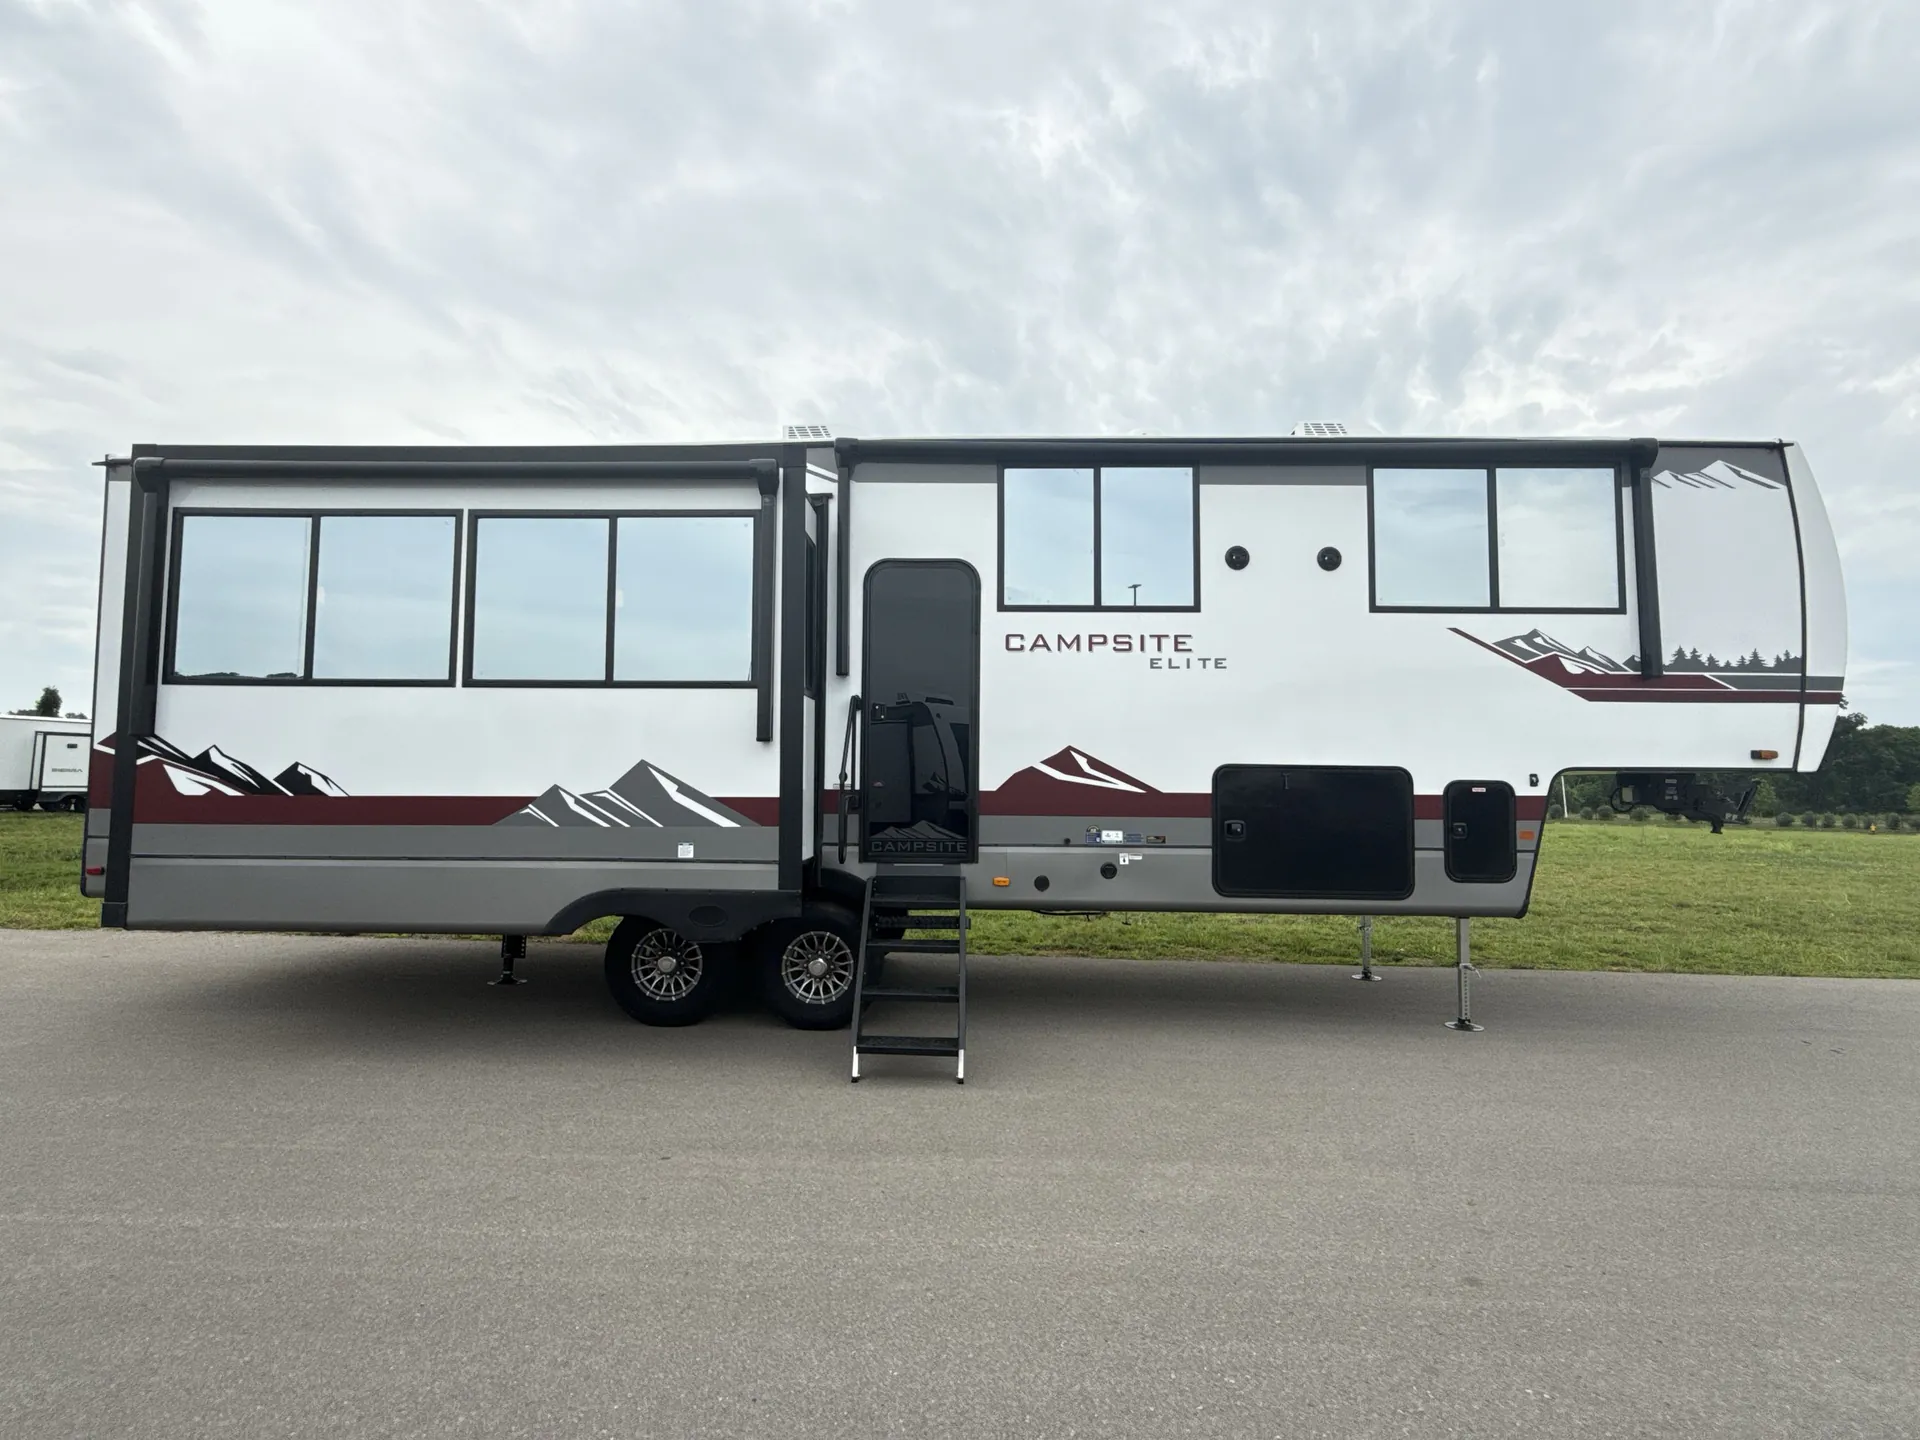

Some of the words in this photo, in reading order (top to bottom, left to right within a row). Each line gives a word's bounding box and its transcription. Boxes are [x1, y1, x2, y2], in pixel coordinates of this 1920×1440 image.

[1005, 634, 1193, 652] CAMPSITE
[1150, 658, 1227, 670] ELITE
[871, 841, 968, 853] CAMPSITE
